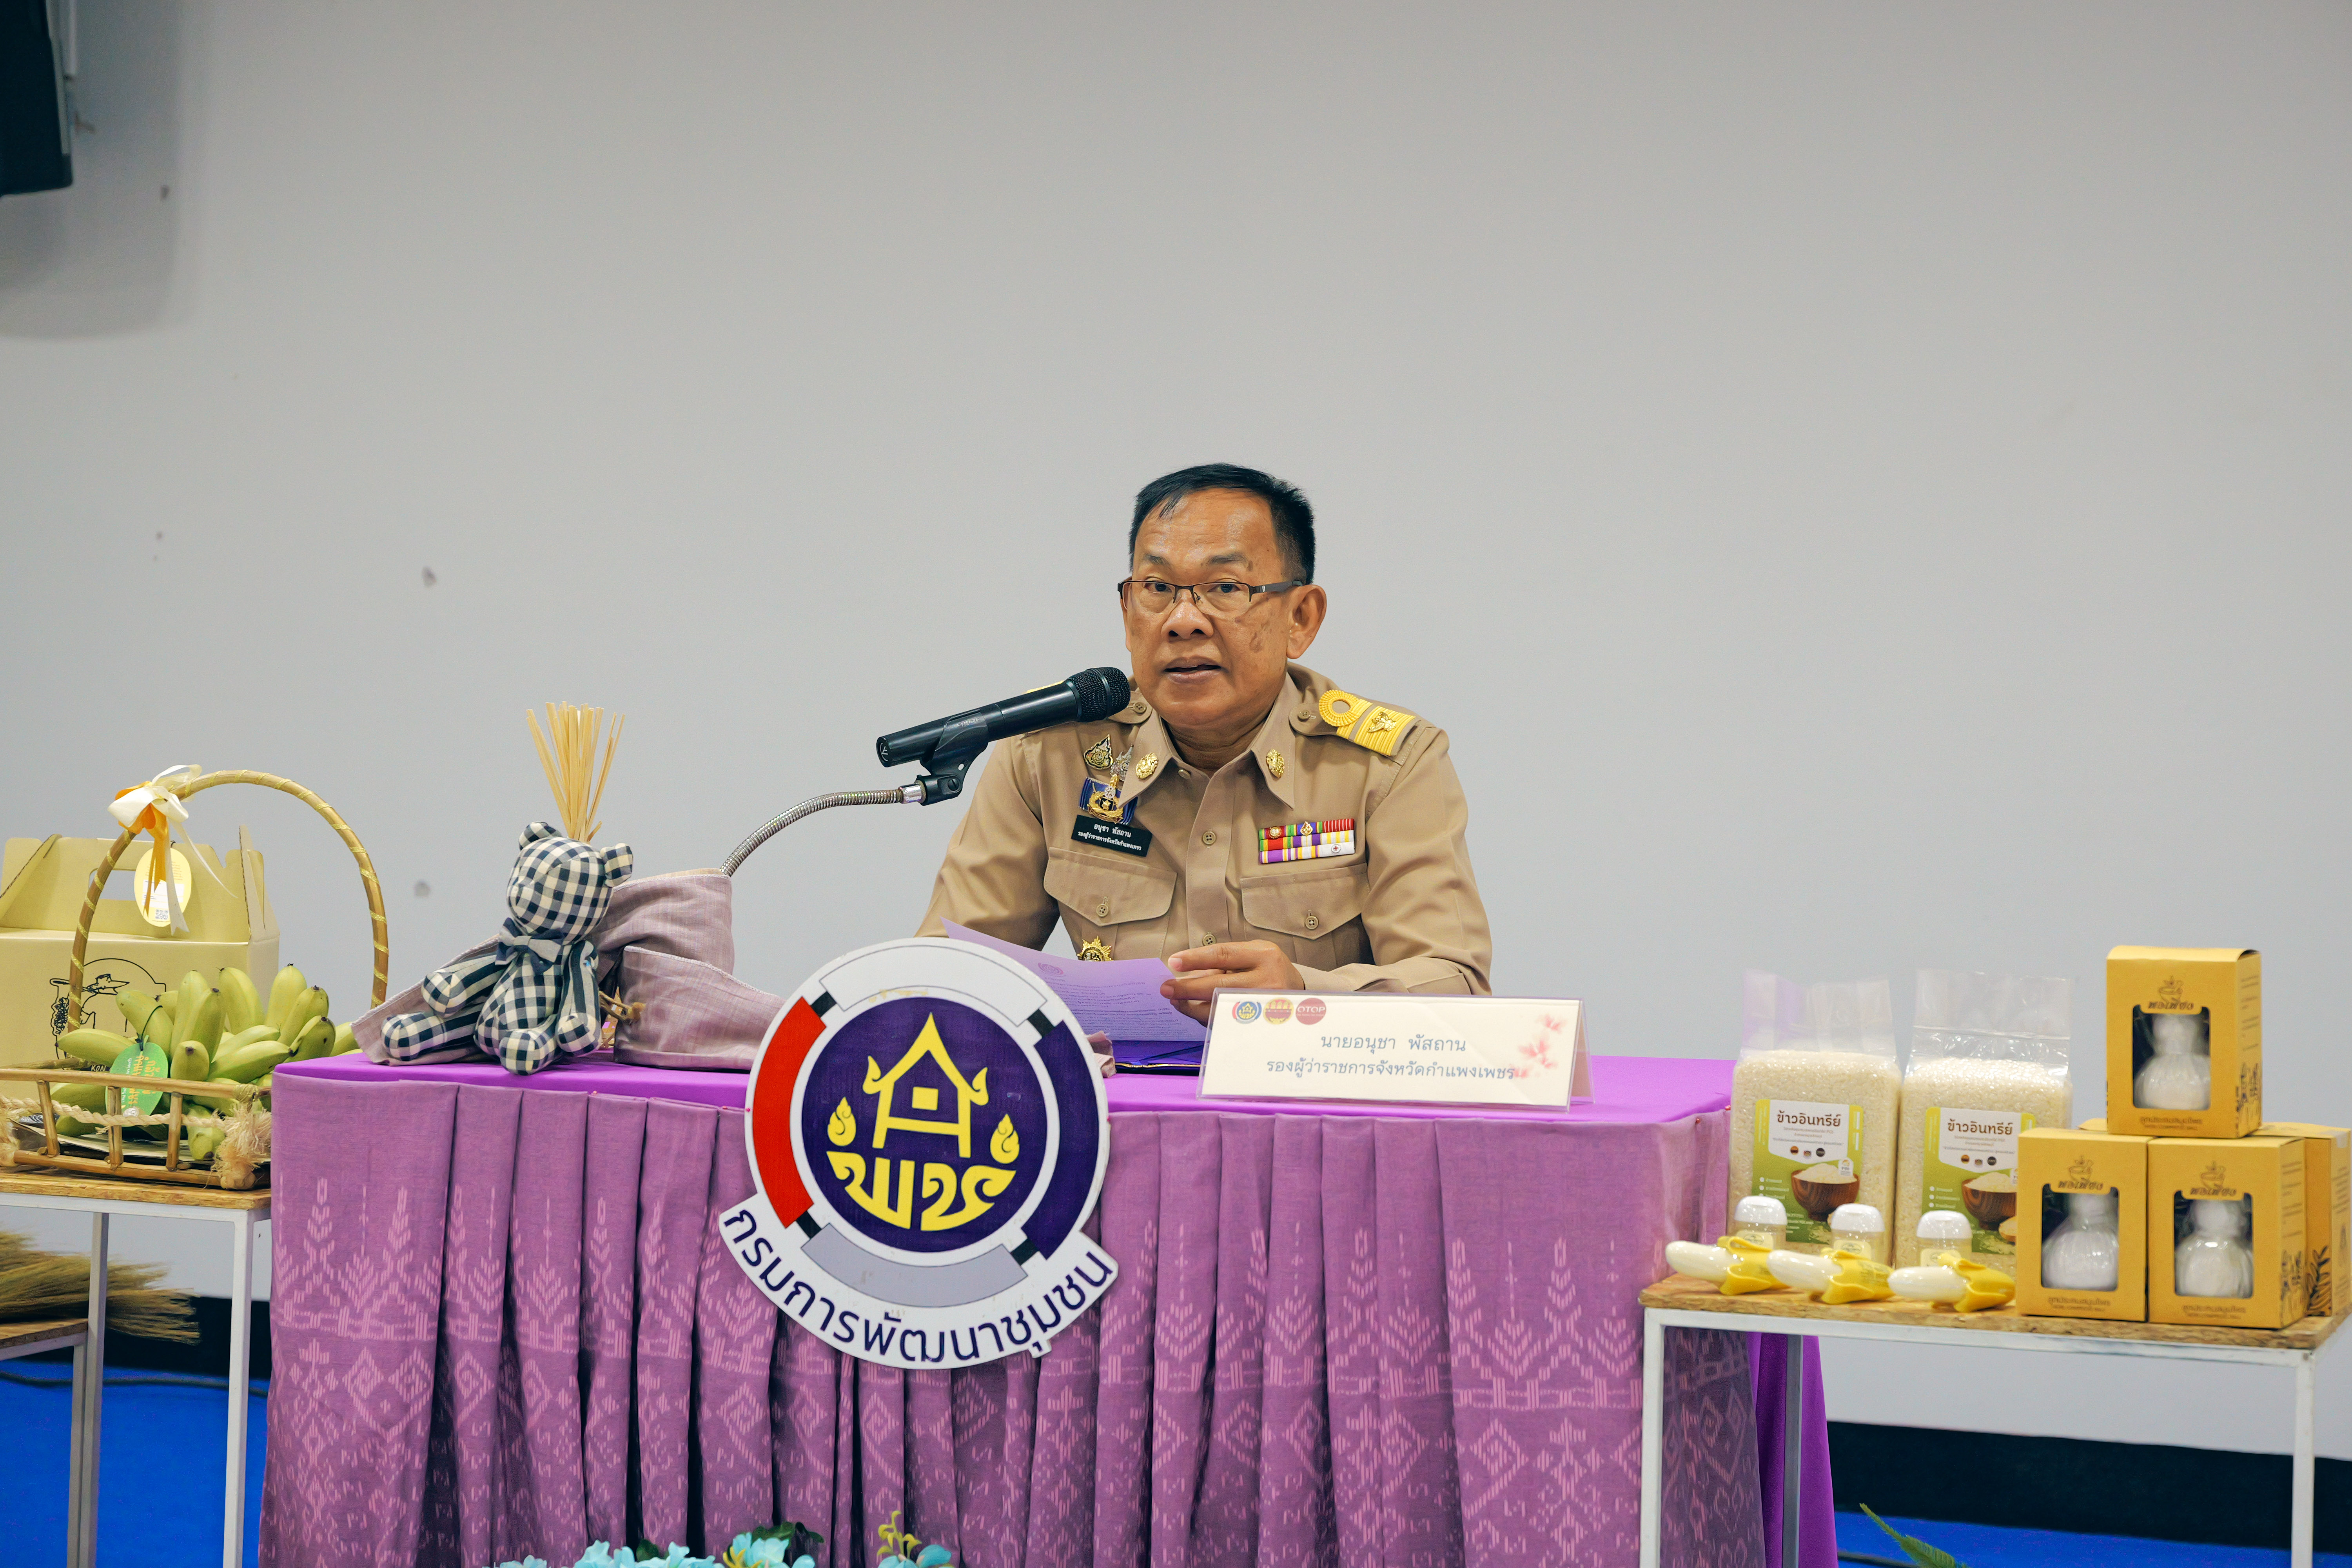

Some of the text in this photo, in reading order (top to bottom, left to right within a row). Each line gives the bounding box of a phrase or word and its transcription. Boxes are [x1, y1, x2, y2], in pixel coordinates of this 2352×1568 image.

[957, 717, 980, 727] SHURE
[1094, 824, 1132, 838] อนุชา พัสถาน
[1321, 1034, 1466, 1054] นายอนุชา พัสถาน
[1267, 1057, 1515, 1080] รองผู้ว่าราชการจังหวัดกำแพงเพชร
[1777, 1110, 1842, 1127] ข้าวอินทรีย์
[1947, 1118, 2014, 1135] ข้าวอินทรีย์
[724, 1209, 1113, 1362] กรมการพัฒนาชุมชน
